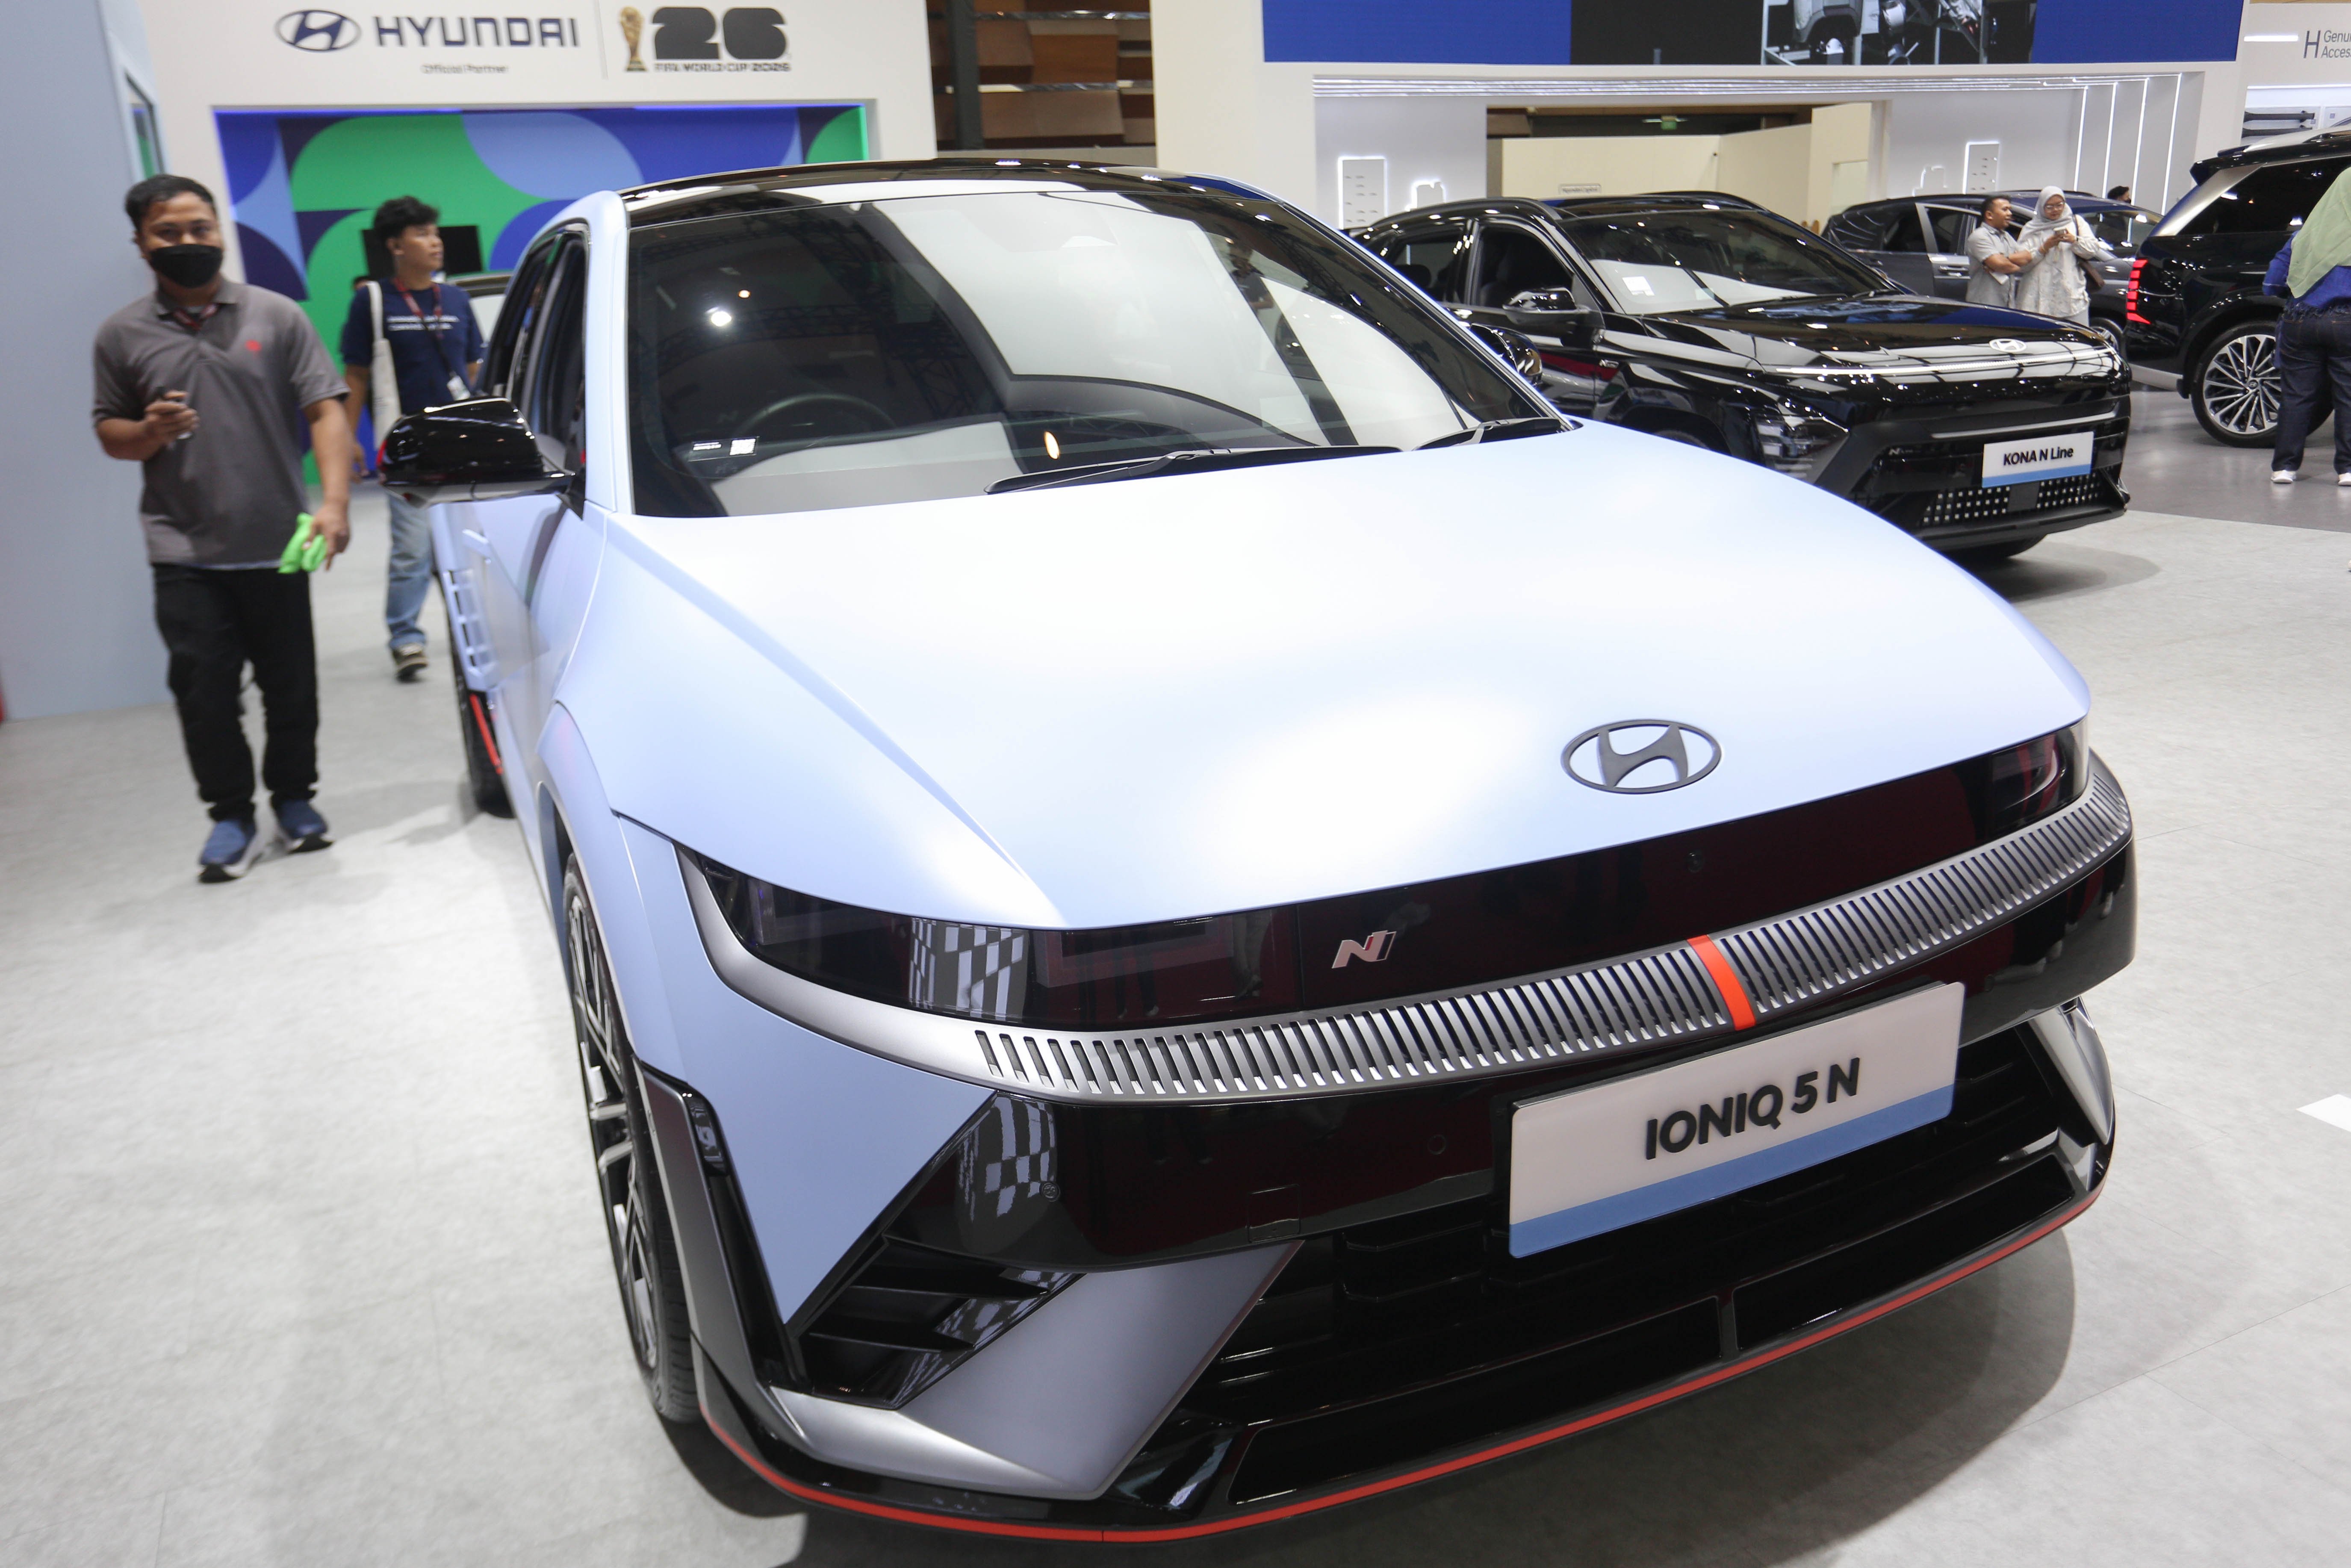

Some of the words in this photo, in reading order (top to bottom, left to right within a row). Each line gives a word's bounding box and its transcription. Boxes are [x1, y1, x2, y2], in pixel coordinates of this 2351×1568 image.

[374, 16, 580, 47] HYUNDAI
[2321, 45, 2351, 59] Acces
[2003, 449, 2037, 466] KONA
[2039, 448, 2048, 461] N
[2050, 446, 2074, 460] Line
[1645, 1085, 1784, 1160] IONIQ
[1791, 1070, 1819, 1114] 5
[1827, 1057, 1860, 1104] N
